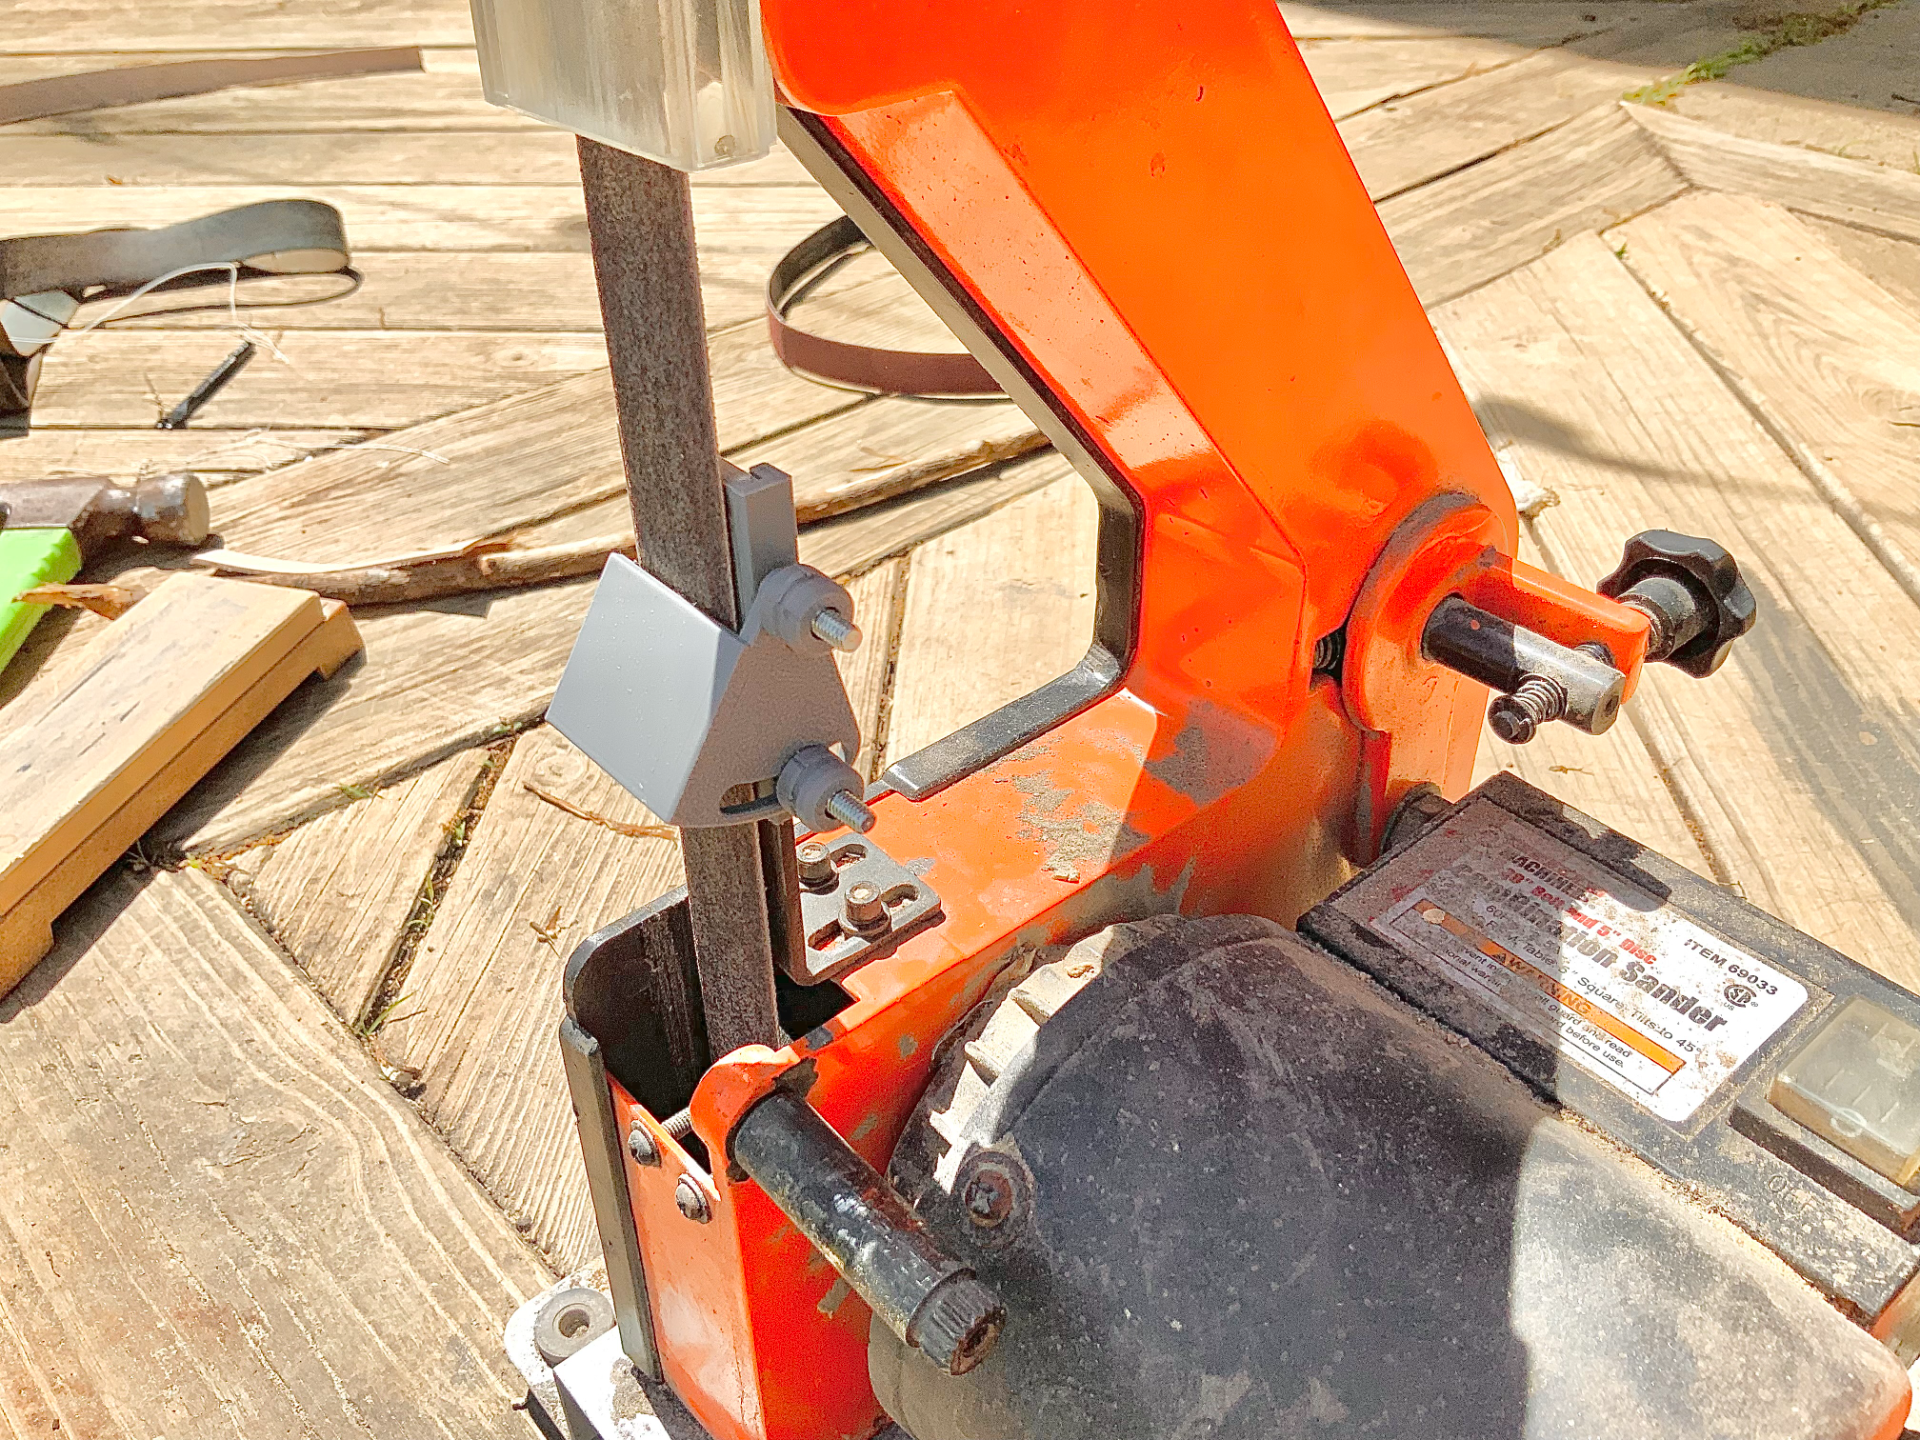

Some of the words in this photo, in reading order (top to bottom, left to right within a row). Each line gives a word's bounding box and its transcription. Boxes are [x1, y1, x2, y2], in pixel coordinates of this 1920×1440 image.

[1618, 937, 1658, 966] Disc
[1683, 937, 1727, 967] ITEM
[1726, 962, 1779, 996] 69033
[1617, 959, 1729, 1035] Sander
[1564, 1025, 1602, 1052] before
[1603, 1037, 1632, 1058] read
